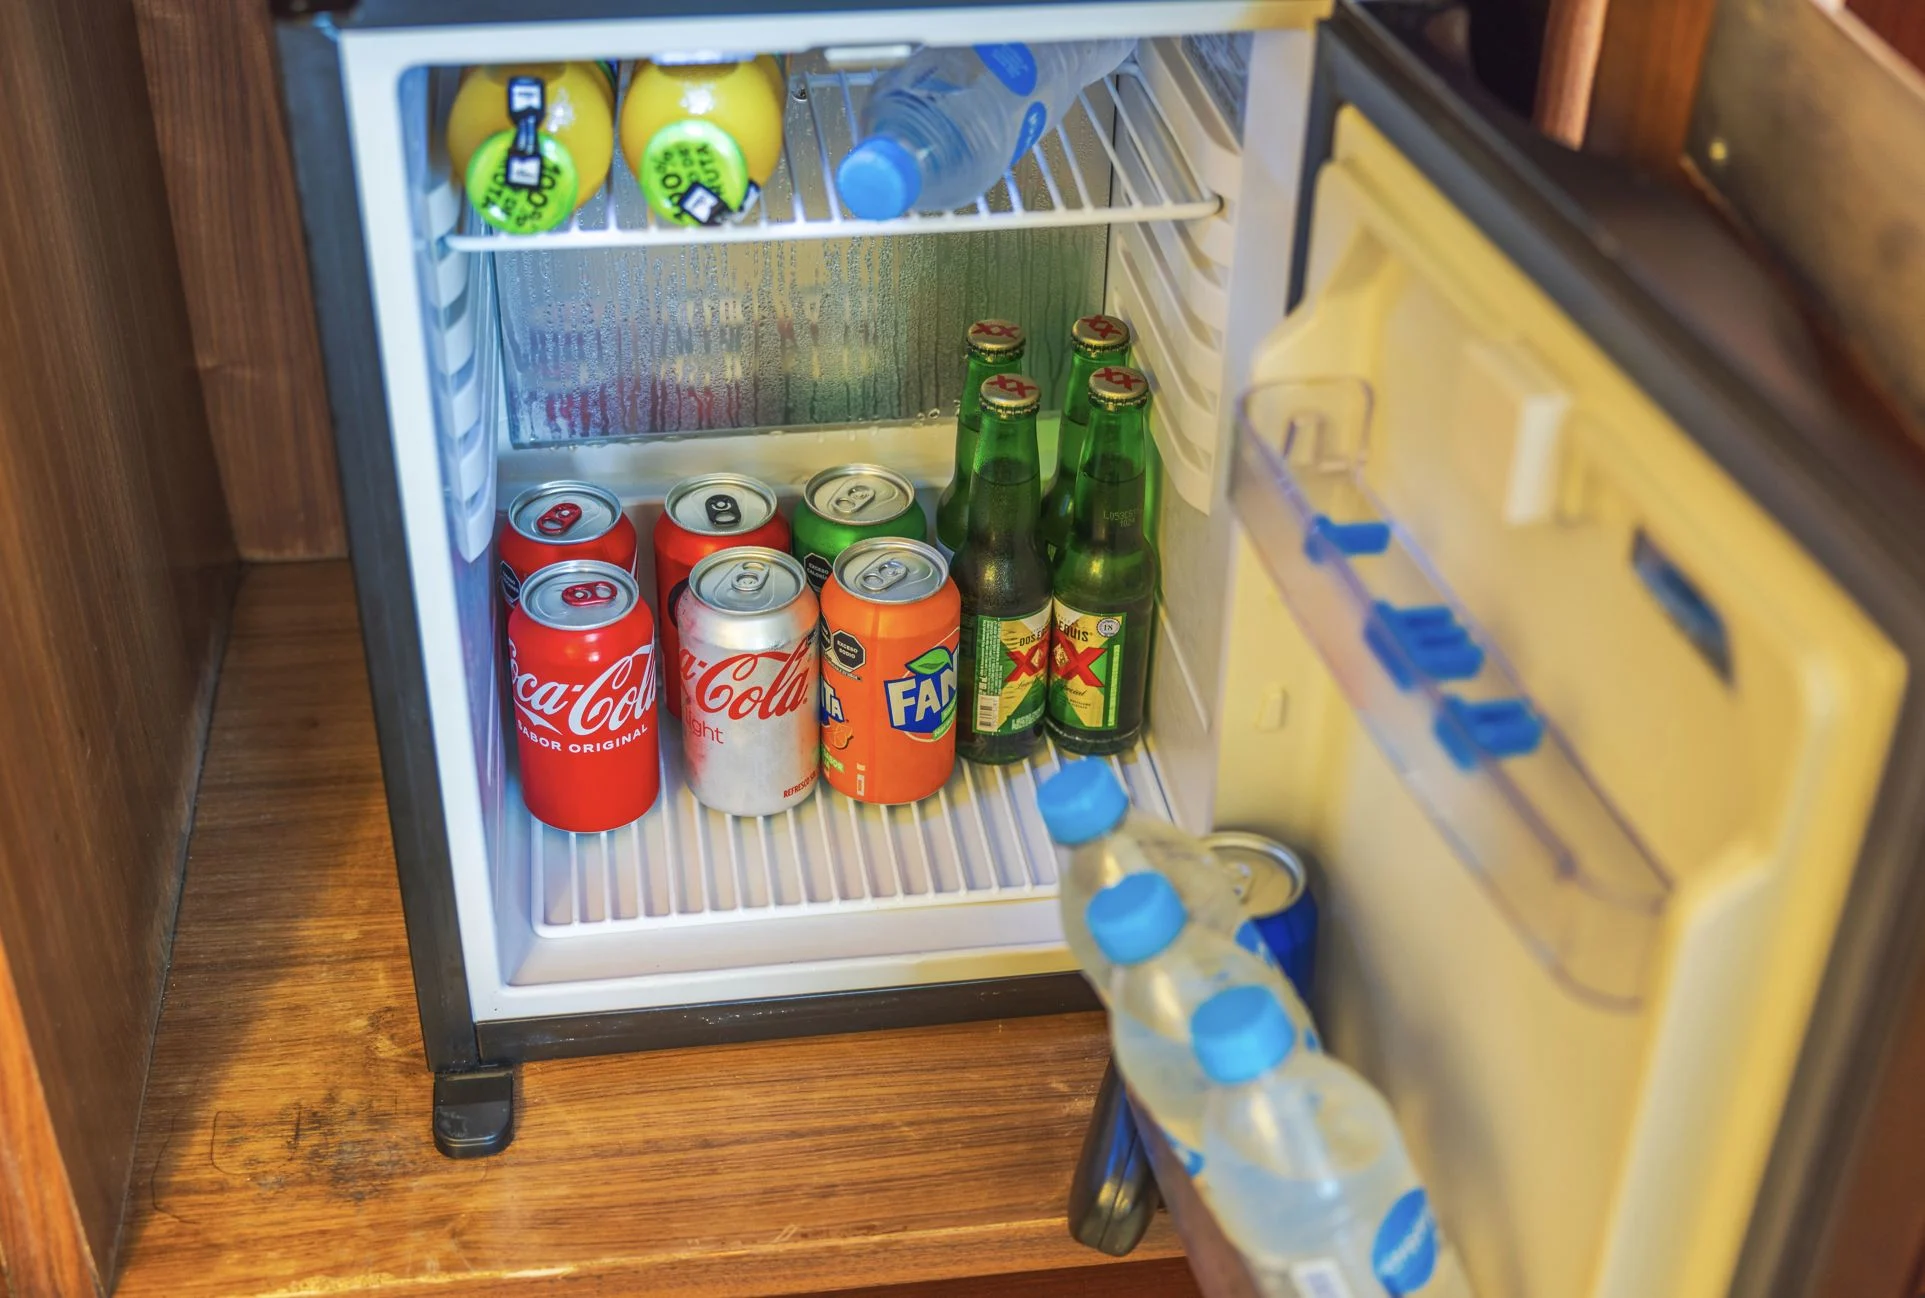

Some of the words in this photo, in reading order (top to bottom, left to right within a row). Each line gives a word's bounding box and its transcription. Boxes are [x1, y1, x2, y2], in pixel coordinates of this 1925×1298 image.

[887, 658, 958, 727] FAN
[517, 719, 562, 752] SABOR
[568, 724, 648, 754] ORIGINAL
